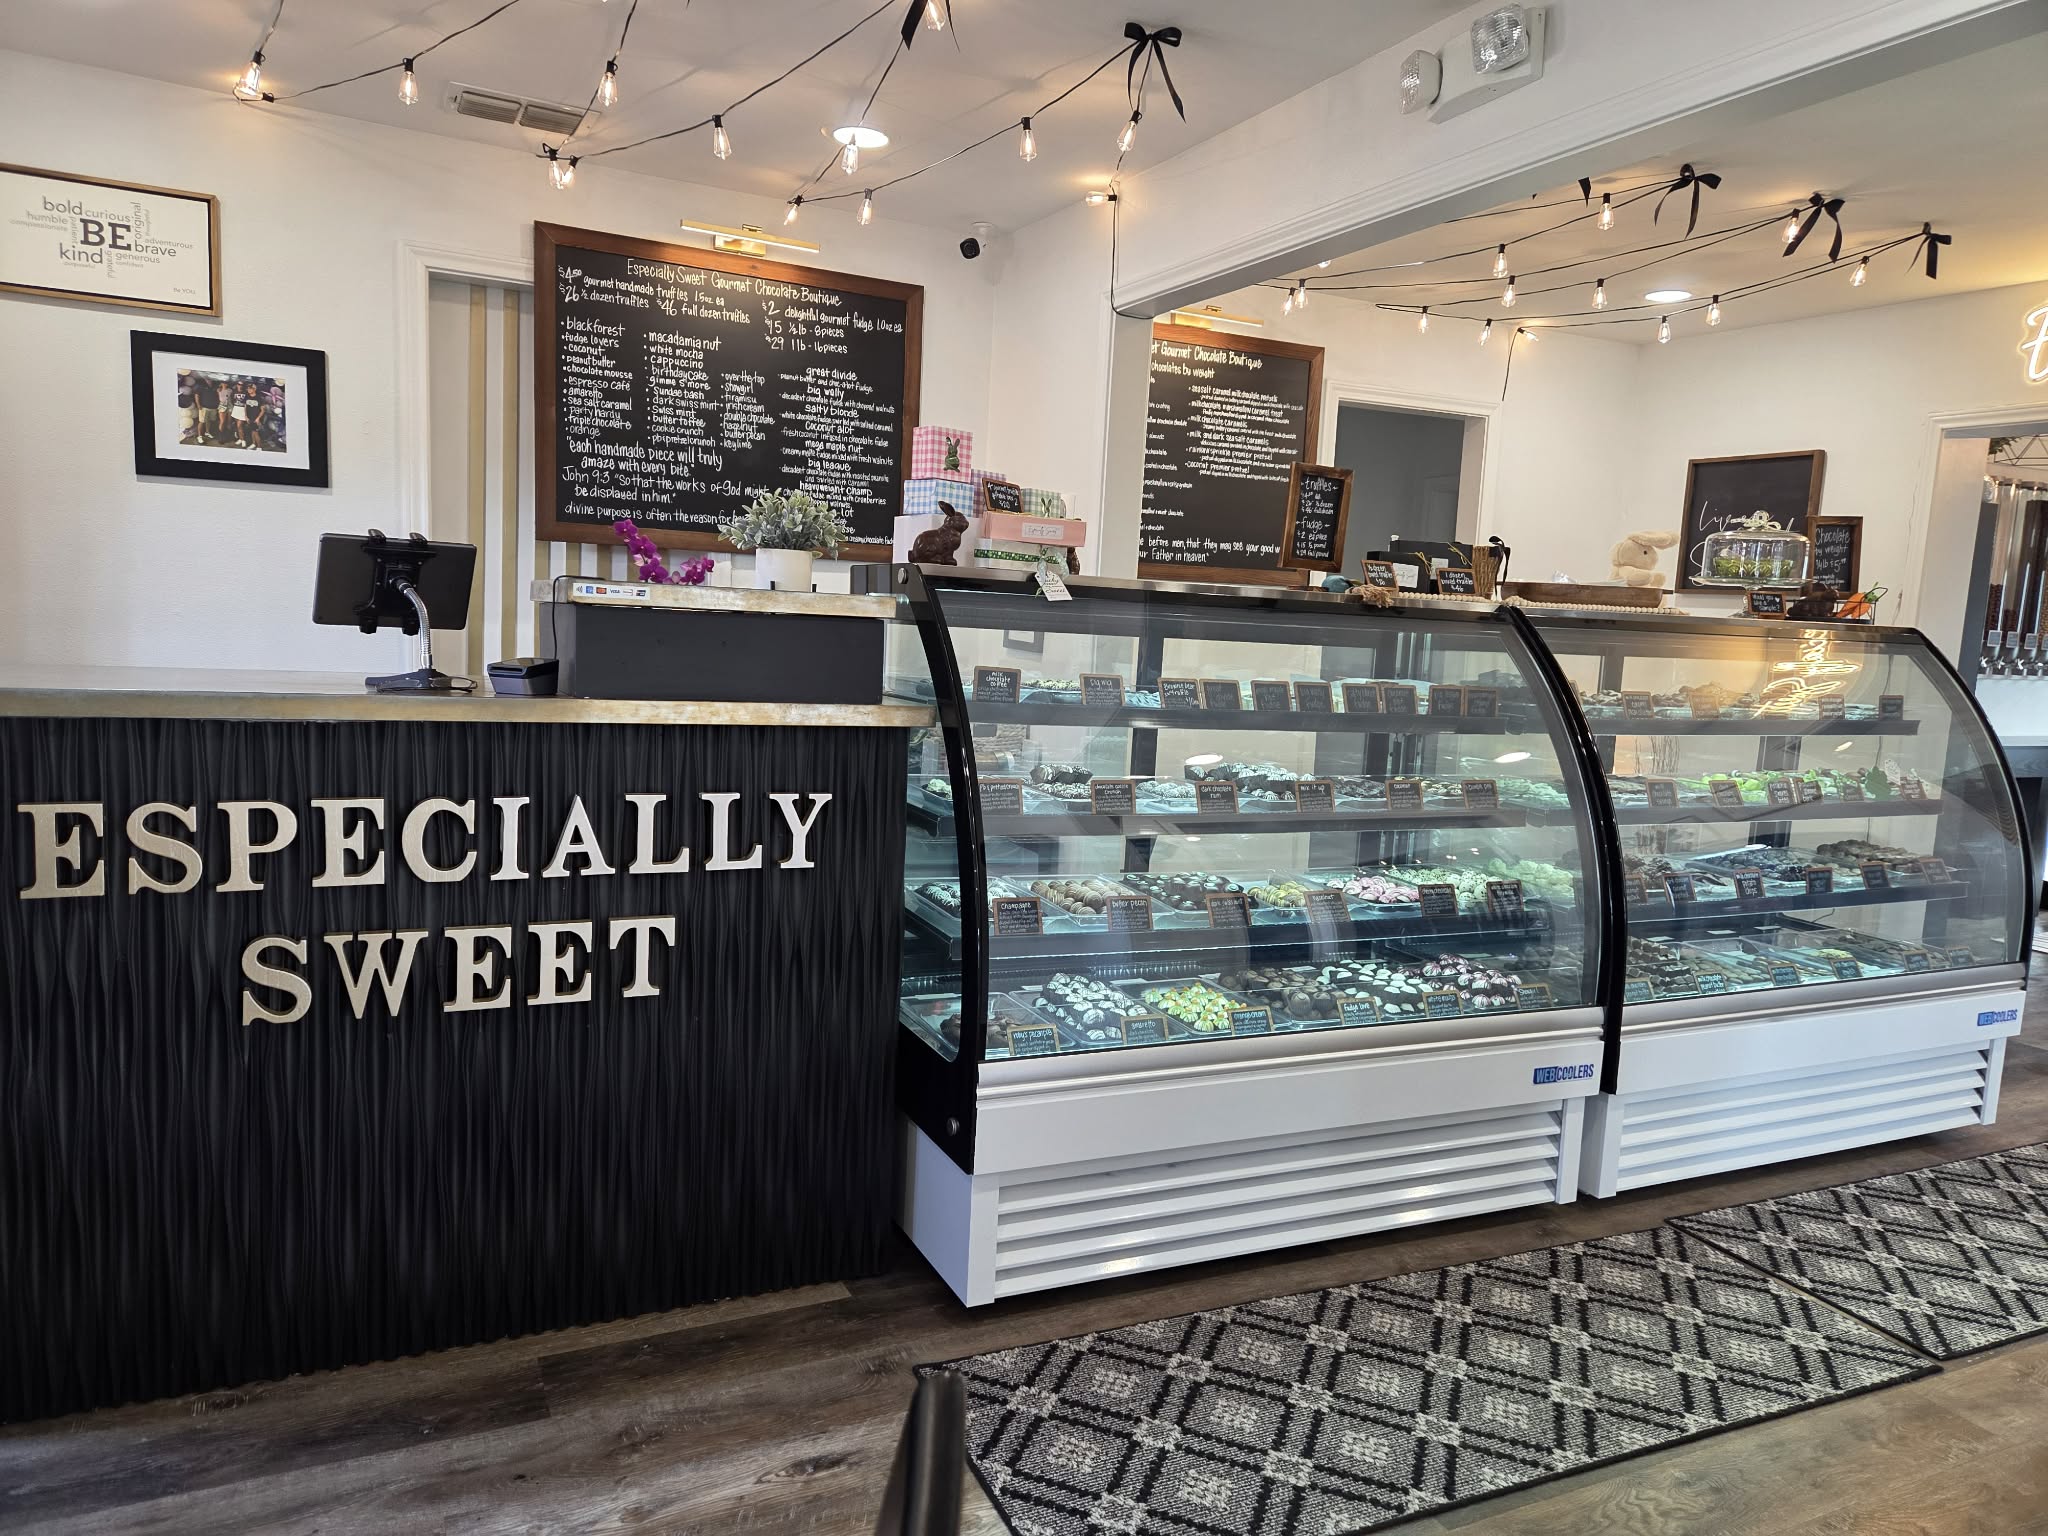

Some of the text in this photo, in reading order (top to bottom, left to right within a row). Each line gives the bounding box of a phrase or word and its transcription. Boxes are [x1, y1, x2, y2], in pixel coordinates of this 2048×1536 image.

[42, 195, 83, 216] bold
[26, 210, 68, 225] humble
[84, 209, 131, 223] curious
[130, 201, 145, 240] original
[69, 215, 79, 245] patient
[79, 217, 132, 252] BE
[134, 239, 177, 258] brave
[144, 237, 194, 250] adventurous
[59, 242, 104, 264] kind
[115, 251, 160, 264] generous
[583, 275, 725, 306] gourmet handmade truffles ea
[627, 258, 843, 307] Especially Sweet Gourmet Chocolate Boutique
[590, 290, 751, 324] dozen truffles $46 full dozen truffles
[566, 315, 626, 337] black forest
[784, 305, 874, 333] delightful gourmet fudge
[564, 331, 620, 348] fudge lovers
[648, 330, 722, 351] macadamia nut
[820, 326, 845, 339] pieces
[568, 343, 606, 357] coconut
[649, 344, 704, 360] white mocha
[823, 342, 848, 354] pieces
[1160, 341, 1192, 359] Gourmet
[1194, 345, 1228, 364] Chocolate
[1229, 350, 1263, 370] Boutique
[566, 354, 616, 368] peanut butter
[650, 354, 704, 369] cappuccino
[566, 364, 633, 380] chocolate mousse
[651, 364, 688, 382] birthday
[805, 367, 858, 381] great divide
[1182, 362, 1215, 379] by weight
[568, 375, 609, 389] espresso
[648, 376, 677, 387] gimme
[568, 386, 603, 400] amaretto
[683, 389, 705, 400] bash
[724, 391, 757, 404] tiramisu
[807, 383, 845, 401] big wally
[567, 396, 600, 408] sea salt
[652, 395, 719, 411] dark swiss mint
[742, 403, 765, 413] cream
[569, 405, 621, 420] party hardy
[675, 408, 697, 419] mint
[804, 403, 860, 418] salty blonde
[567, 413, 632, 431] triple chocolate
[652, 415, 706, 428] butter toffee
[569, 425, 601, 440] orange
[651, 424, 704, 437] cookie crunch
[723, 438, 753, 452] key lime
[804, 439, 864, 454] mega maple nut
[594, 439, 723, 472] handmade piece truly
[580, 455, 667, 476] amaze with every
[807, 458, 821, 470] big
[561, 465, 722, 494] John 9:3 that the works of
[1304, 476, 1332, 492] truffles
[574, 484, 651, 502] be displayed in
[564, 501, 595, 516] divine
[596, 506, 632, 521] purpose
[632, 507, 643, 519] is
[645, 507, 672, 522] often
[672, 509, 690, 522] the
[689, 513, 718, 525] reason
[718, 509, 732, 525] for
[1301, 515, 1323, 534] fudge
[1815, 527, 1850, 546] Chocolate
[1148, 535, 1170, 548] before
[1186, 537, 1201, 549] that
[1203, 537, 1218, 554] they
[1219, 540, 1232, 553] may
[1232, 541, 1244, 551] see
[1245, 543, 1260, 557] your
[1260, 543, 1274, 556] good
[1824, 544, 1848, 557] weight
[1175, 552, 1182, 561] in
[1315, 550, 1329, 559] pound
[18, 793, 832, 900] ESPECIALLY
[242, 915, 676, 1027] SWEET
[1533, 1064, 1595, 1085] WEBCOOLERS
